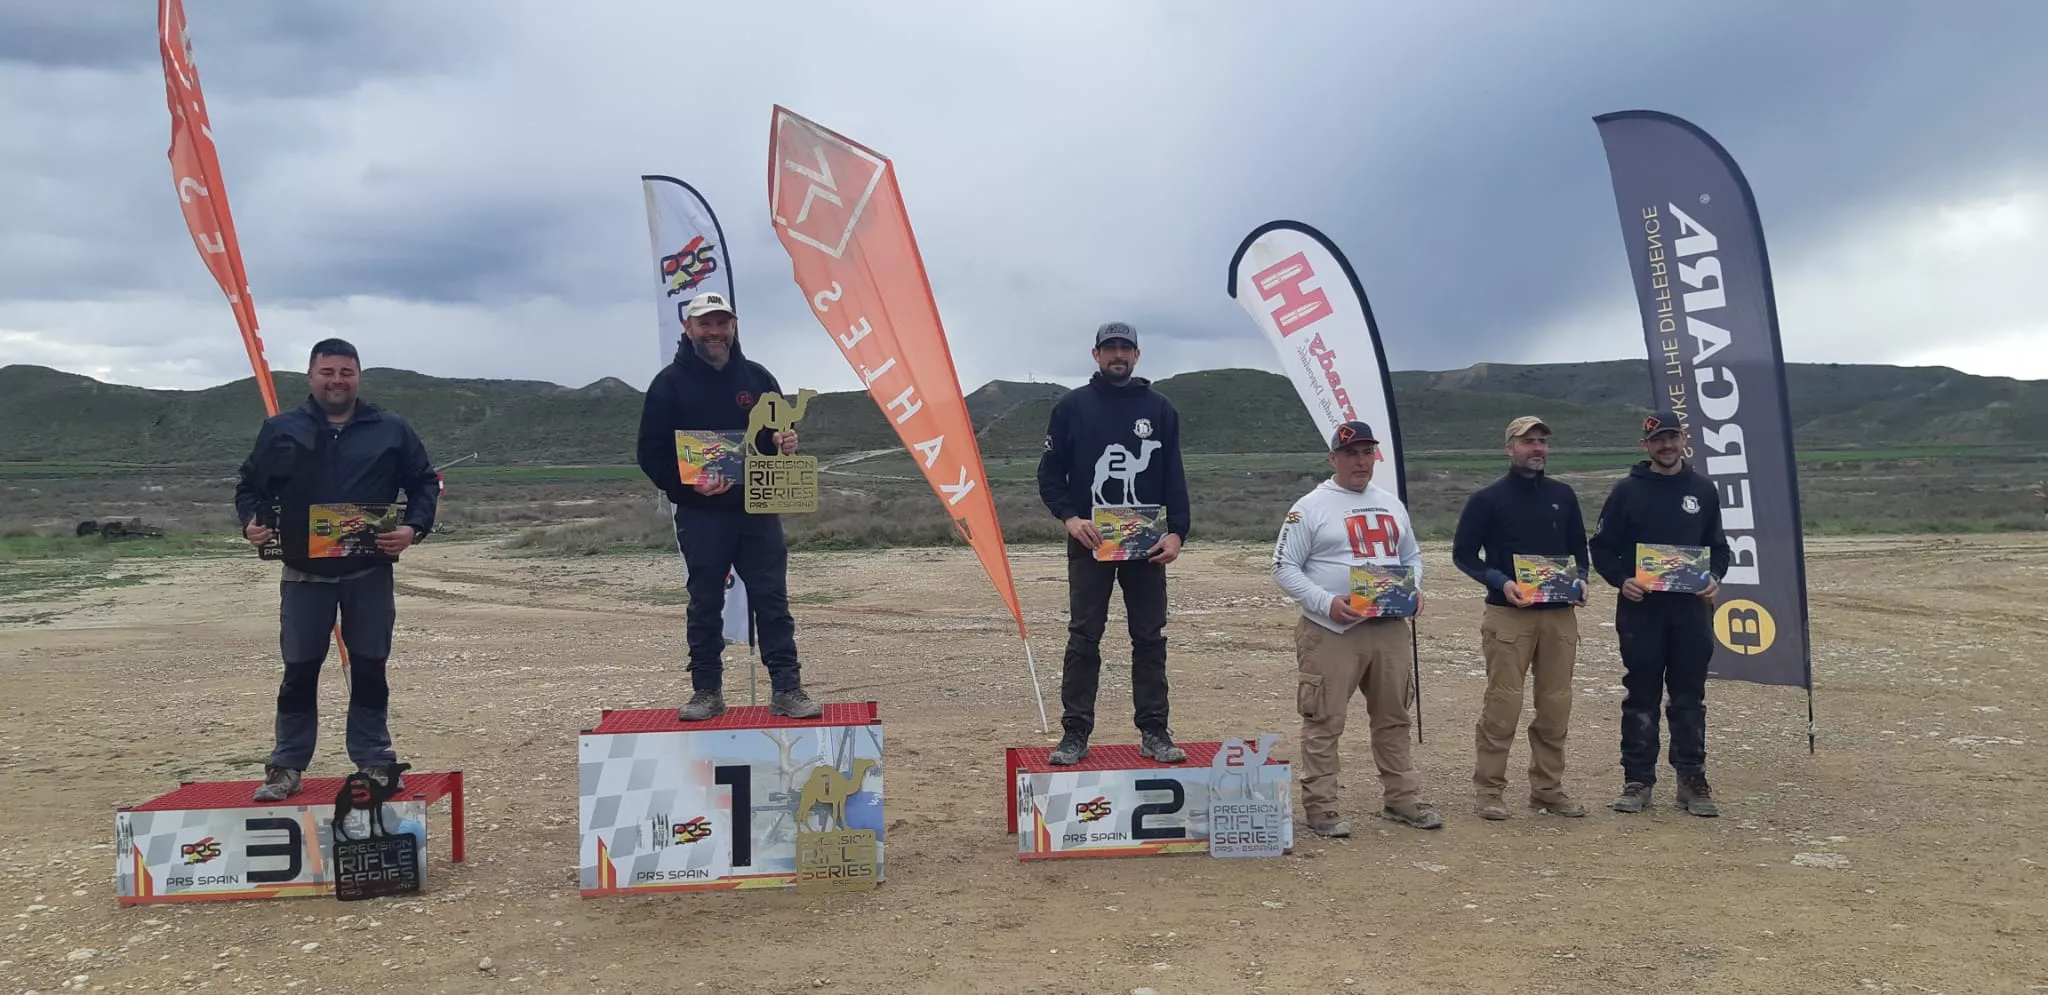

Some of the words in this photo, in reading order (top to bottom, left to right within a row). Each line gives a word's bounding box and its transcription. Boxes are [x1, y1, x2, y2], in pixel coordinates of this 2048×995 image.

[660, 244, 717, 284] PRS
[768, 401, 776, 422] 1
[750, 460, 814, 470] PRECISION
[1109, 451, 1127, 471] 2
[749, 471, 814, 486] RIFLE
[749, 487, 814, 500] SERIES
[750, 501, 769, 509] PRS
[1344, 514, 1400, 558] H
[1226, 746, 1244, 766] 2
[350, 779, 372, 802] 3
[714, 765, 751, 867] 1
[1075, 801, 1112, 817] PRS
[1131, 778, 1186, 840] 2
[1213, 803, 1279, 814] PRECISION
[672, 820, 713, 840] PRS
[1214, 814, 1280, 830] RIFLE
[1062, 834, 1088, 843] PRS
[1091, 832, 1128, 842] SPAIN
[1214, 831, 1280, 844] SERIES
[180, 842, 222, 860] PRS
[245, 817, 302, 883] 3
[338, 839, 413, 856] PRECISION
[1214, 845, 1234, 853] PRS
[338, 848, 413, 874] RIFLE
[166, 876, 195, 887] PRS
[197, 874, 239, 886] SPAIN
[636, 870, 666, 881] PRS
[668, 868, 710, 880] SPAIN
[801, 863, 873, 881] SERIES
